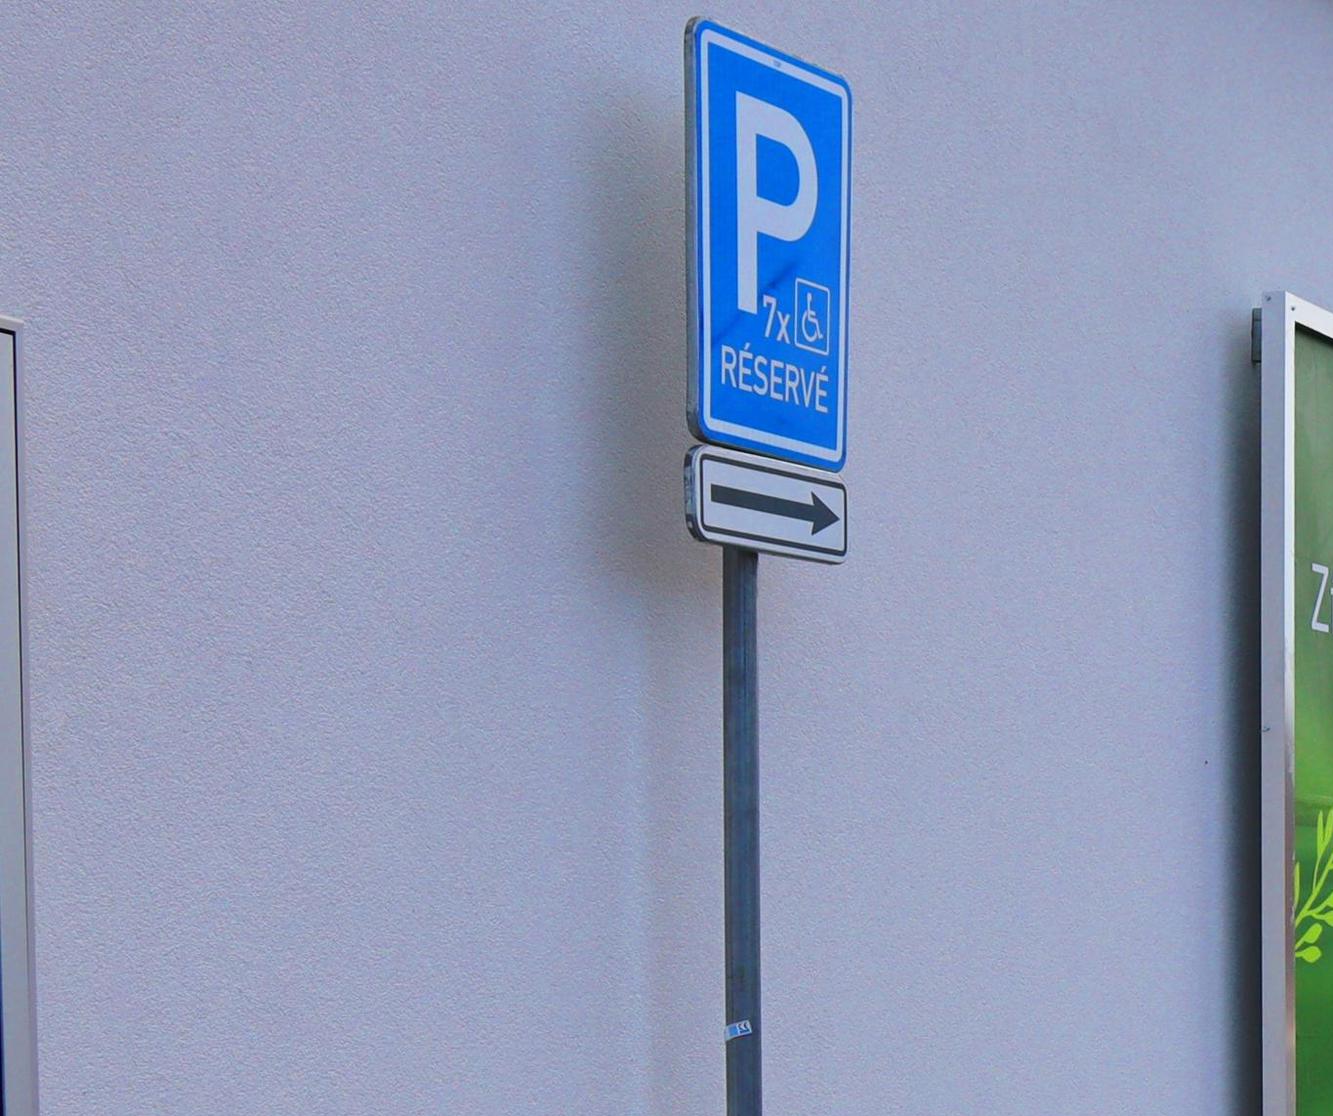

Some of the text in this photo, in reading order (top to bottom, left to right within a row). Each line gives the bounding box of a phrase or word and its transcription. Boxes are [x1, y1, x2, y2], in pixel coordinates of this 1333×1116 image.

[736, 90, 818, 315] P
[762, 294, 791, 344] 7x
[720, 342, 829, 414] RÉSERVÉ
